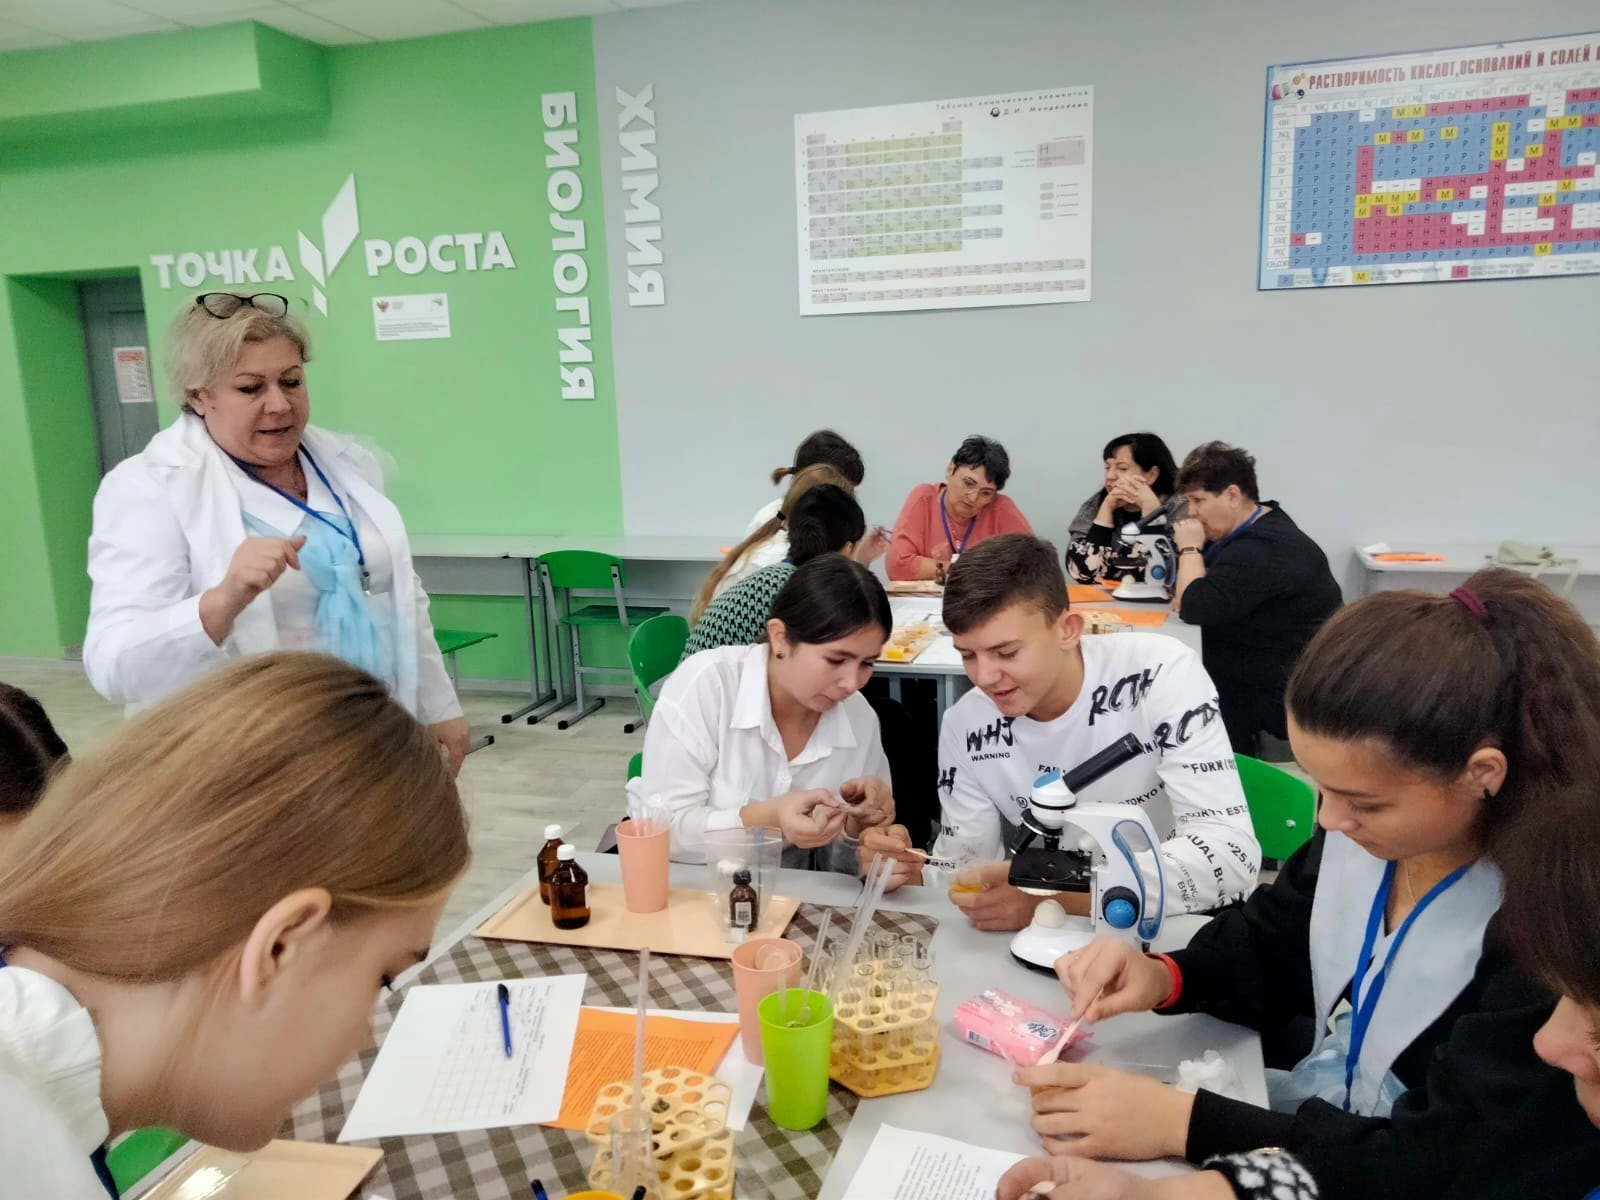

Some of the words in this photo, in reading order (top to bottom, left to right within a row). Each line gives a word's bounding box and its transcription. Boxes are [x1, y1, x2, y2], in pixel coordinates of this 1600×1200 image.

[1309, 67, 1405, 89] РАСТВОРИМОСТЬ
[1536, 52, 1545, 67] И
[1550, 44, 1591, 65] СОЛЕЙ
[615, 83, 665, 307] ХИМИЯ
[150, 246, 295, 289] ТОЧКА
[364, 231, 516, 277] РОСТА
[541, 91, 595, 400] БИОЛОГИЯ
[971, 752, 1011, 762] WARNING
[1125, 788, 1158, 806] TOKYO
